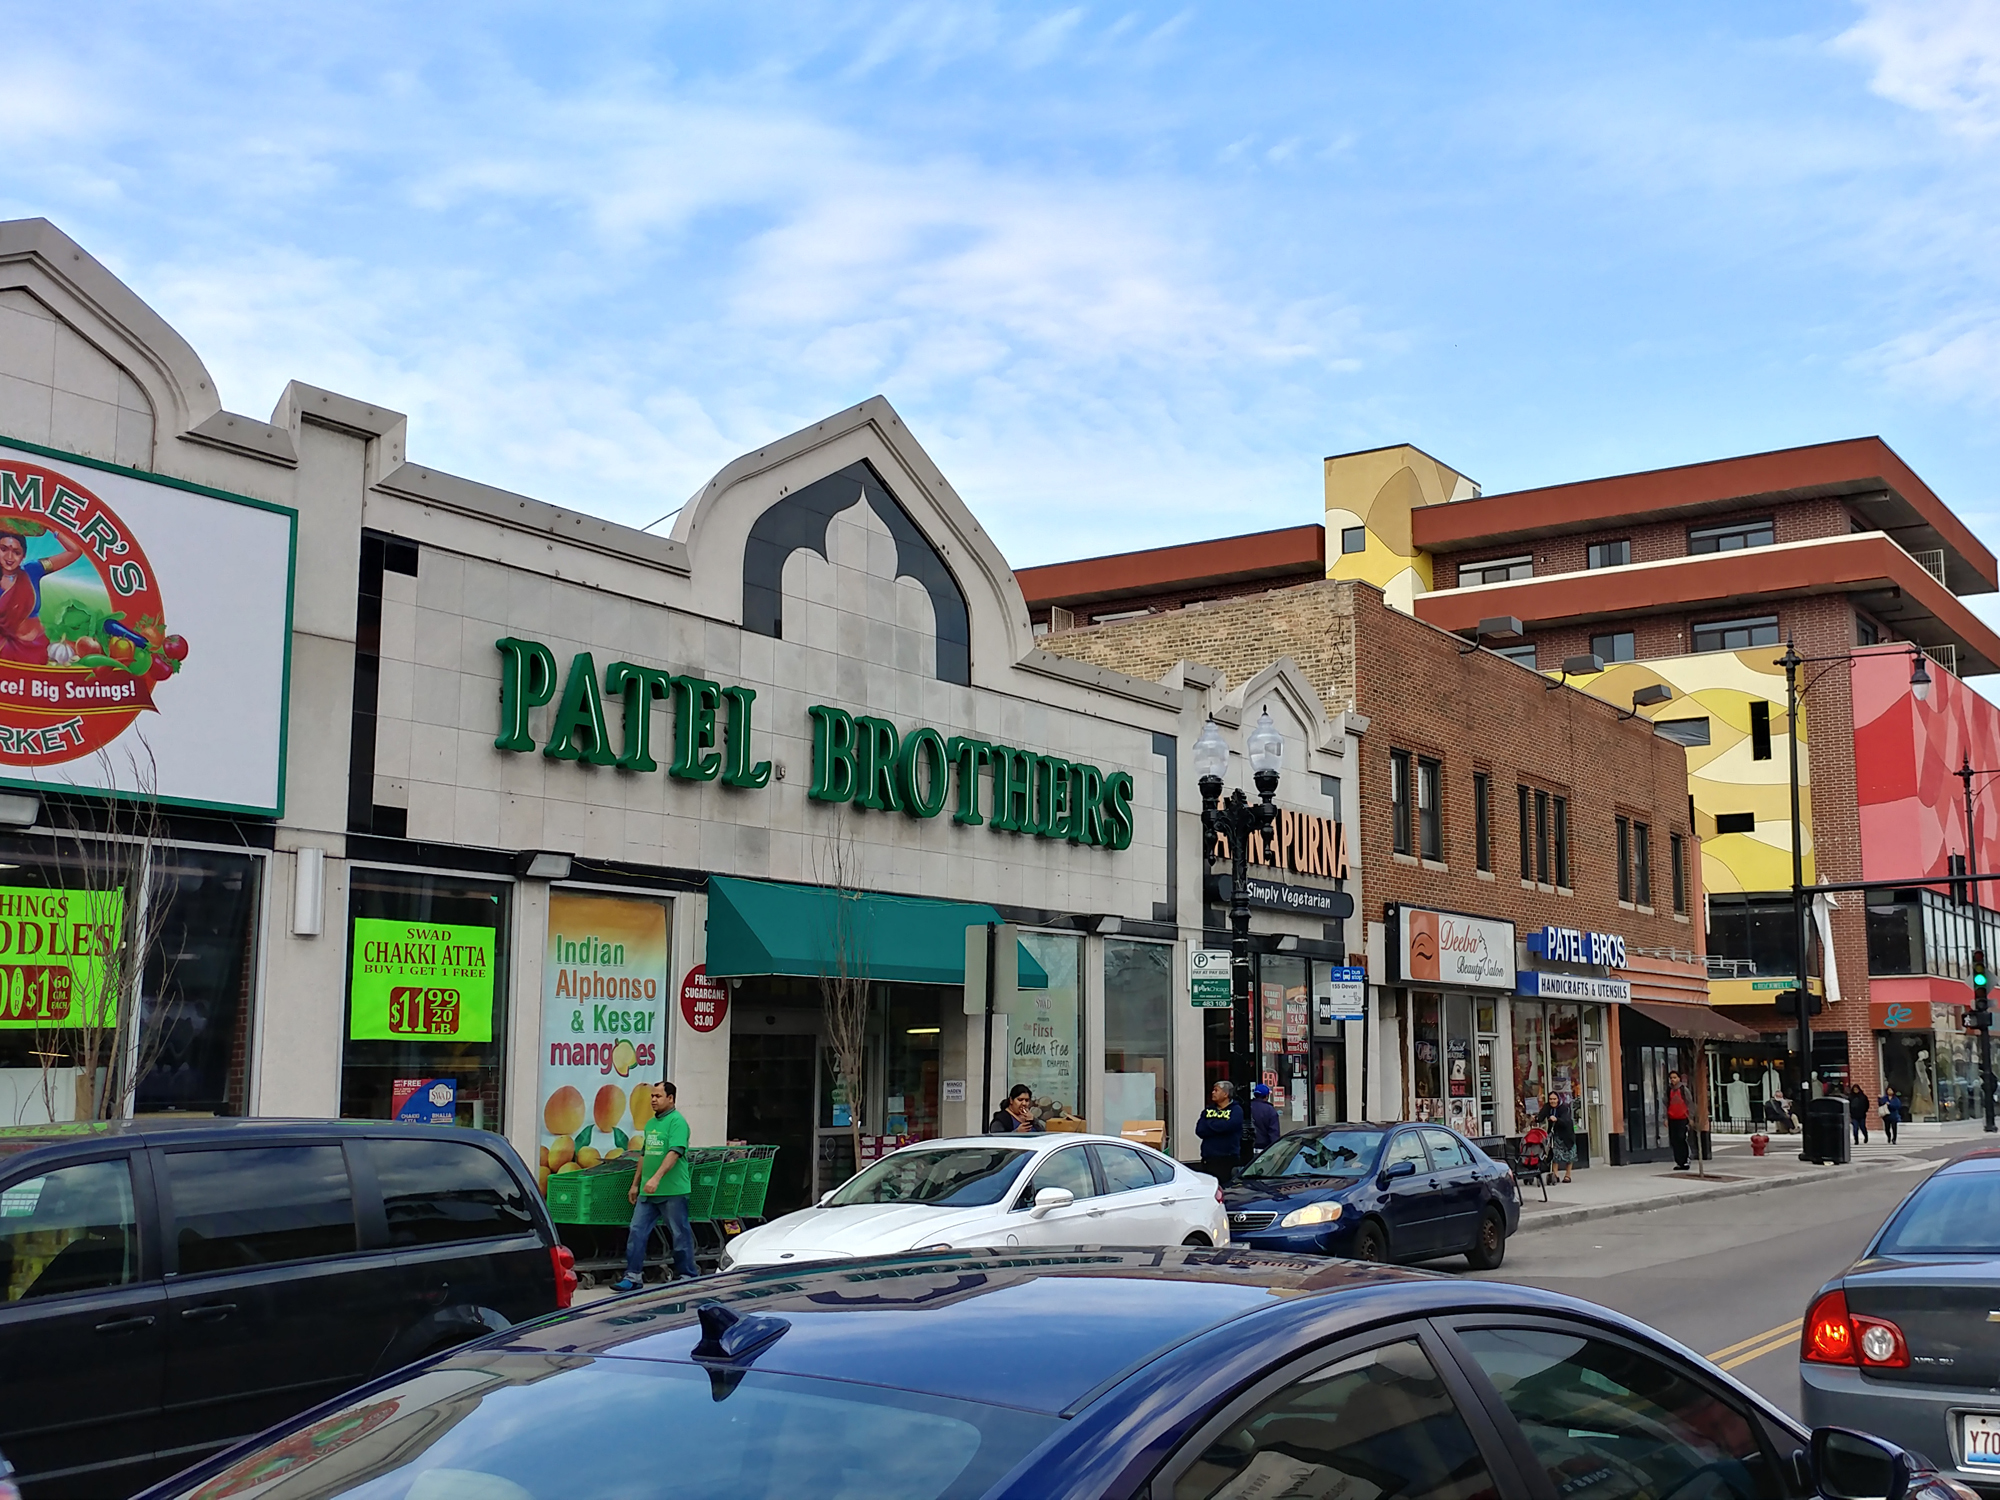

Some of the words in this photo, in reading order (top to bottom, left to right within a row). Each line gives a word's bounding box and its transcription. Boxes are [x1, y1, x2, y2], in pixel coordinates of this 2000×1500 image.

[31, 680, 59, 702] Big
[65, 680, 136, 701] Savings!
[494, 637, 772, 788] PATEL
[808, 705, 1133, 850] BROTHERS
[1213, 794, 1351, 880] ANAPURNA
[1246, 882, 1279, 904] Simply
[1282, 887, 1331, 909] Vegetarian
[406, 928, 452, 942] SWAD
[1440, 920, 1479, 954] Deeba
[1547, 926, 1588, 963] PATEL
[364, 941, 436, 965] CHAKKI
[441, 944, 486, 967] ATTA
[556, 934, 625, 966] Indian
[364, 964, 394, 974] BUY
[399, 966, 404, 974] 1
[409, 966, 437, 976] GET
[442, 968, 448, 976] 1
[453, 968, 486, 978] FREE
[1457, 956, 1482, 981] Beauty
[1483, 957, 1504, 978] Salon
[54, 975, 70, 989] 60
[555, 969, 657, 1004] Alphonso
[1541, 978, 1589, 996] HANDICRAFTS
[1591, 984, 1596, 997] &
[1598, 984, 1627, 999] UTENSILS
[685, 987, 725, 1000] SUGARCANE
[432, 1009, 453, 1022] 20
[694, 1001, 715, 1013] JUICE
[431, 1023, 454, 1034] LB.
[571, 1009, 585, 1032] &
[594, 1004, 655, 1033] Kesar
[694, 1014, 714, 1026] $3.00
[1033, 1022, 1054, 1037] First
[1014, 1037, 1046, 1056] Gluten
[1050, 1039, 1069, 1056] Free
[431, 1090, 452, 1101] SWAD
